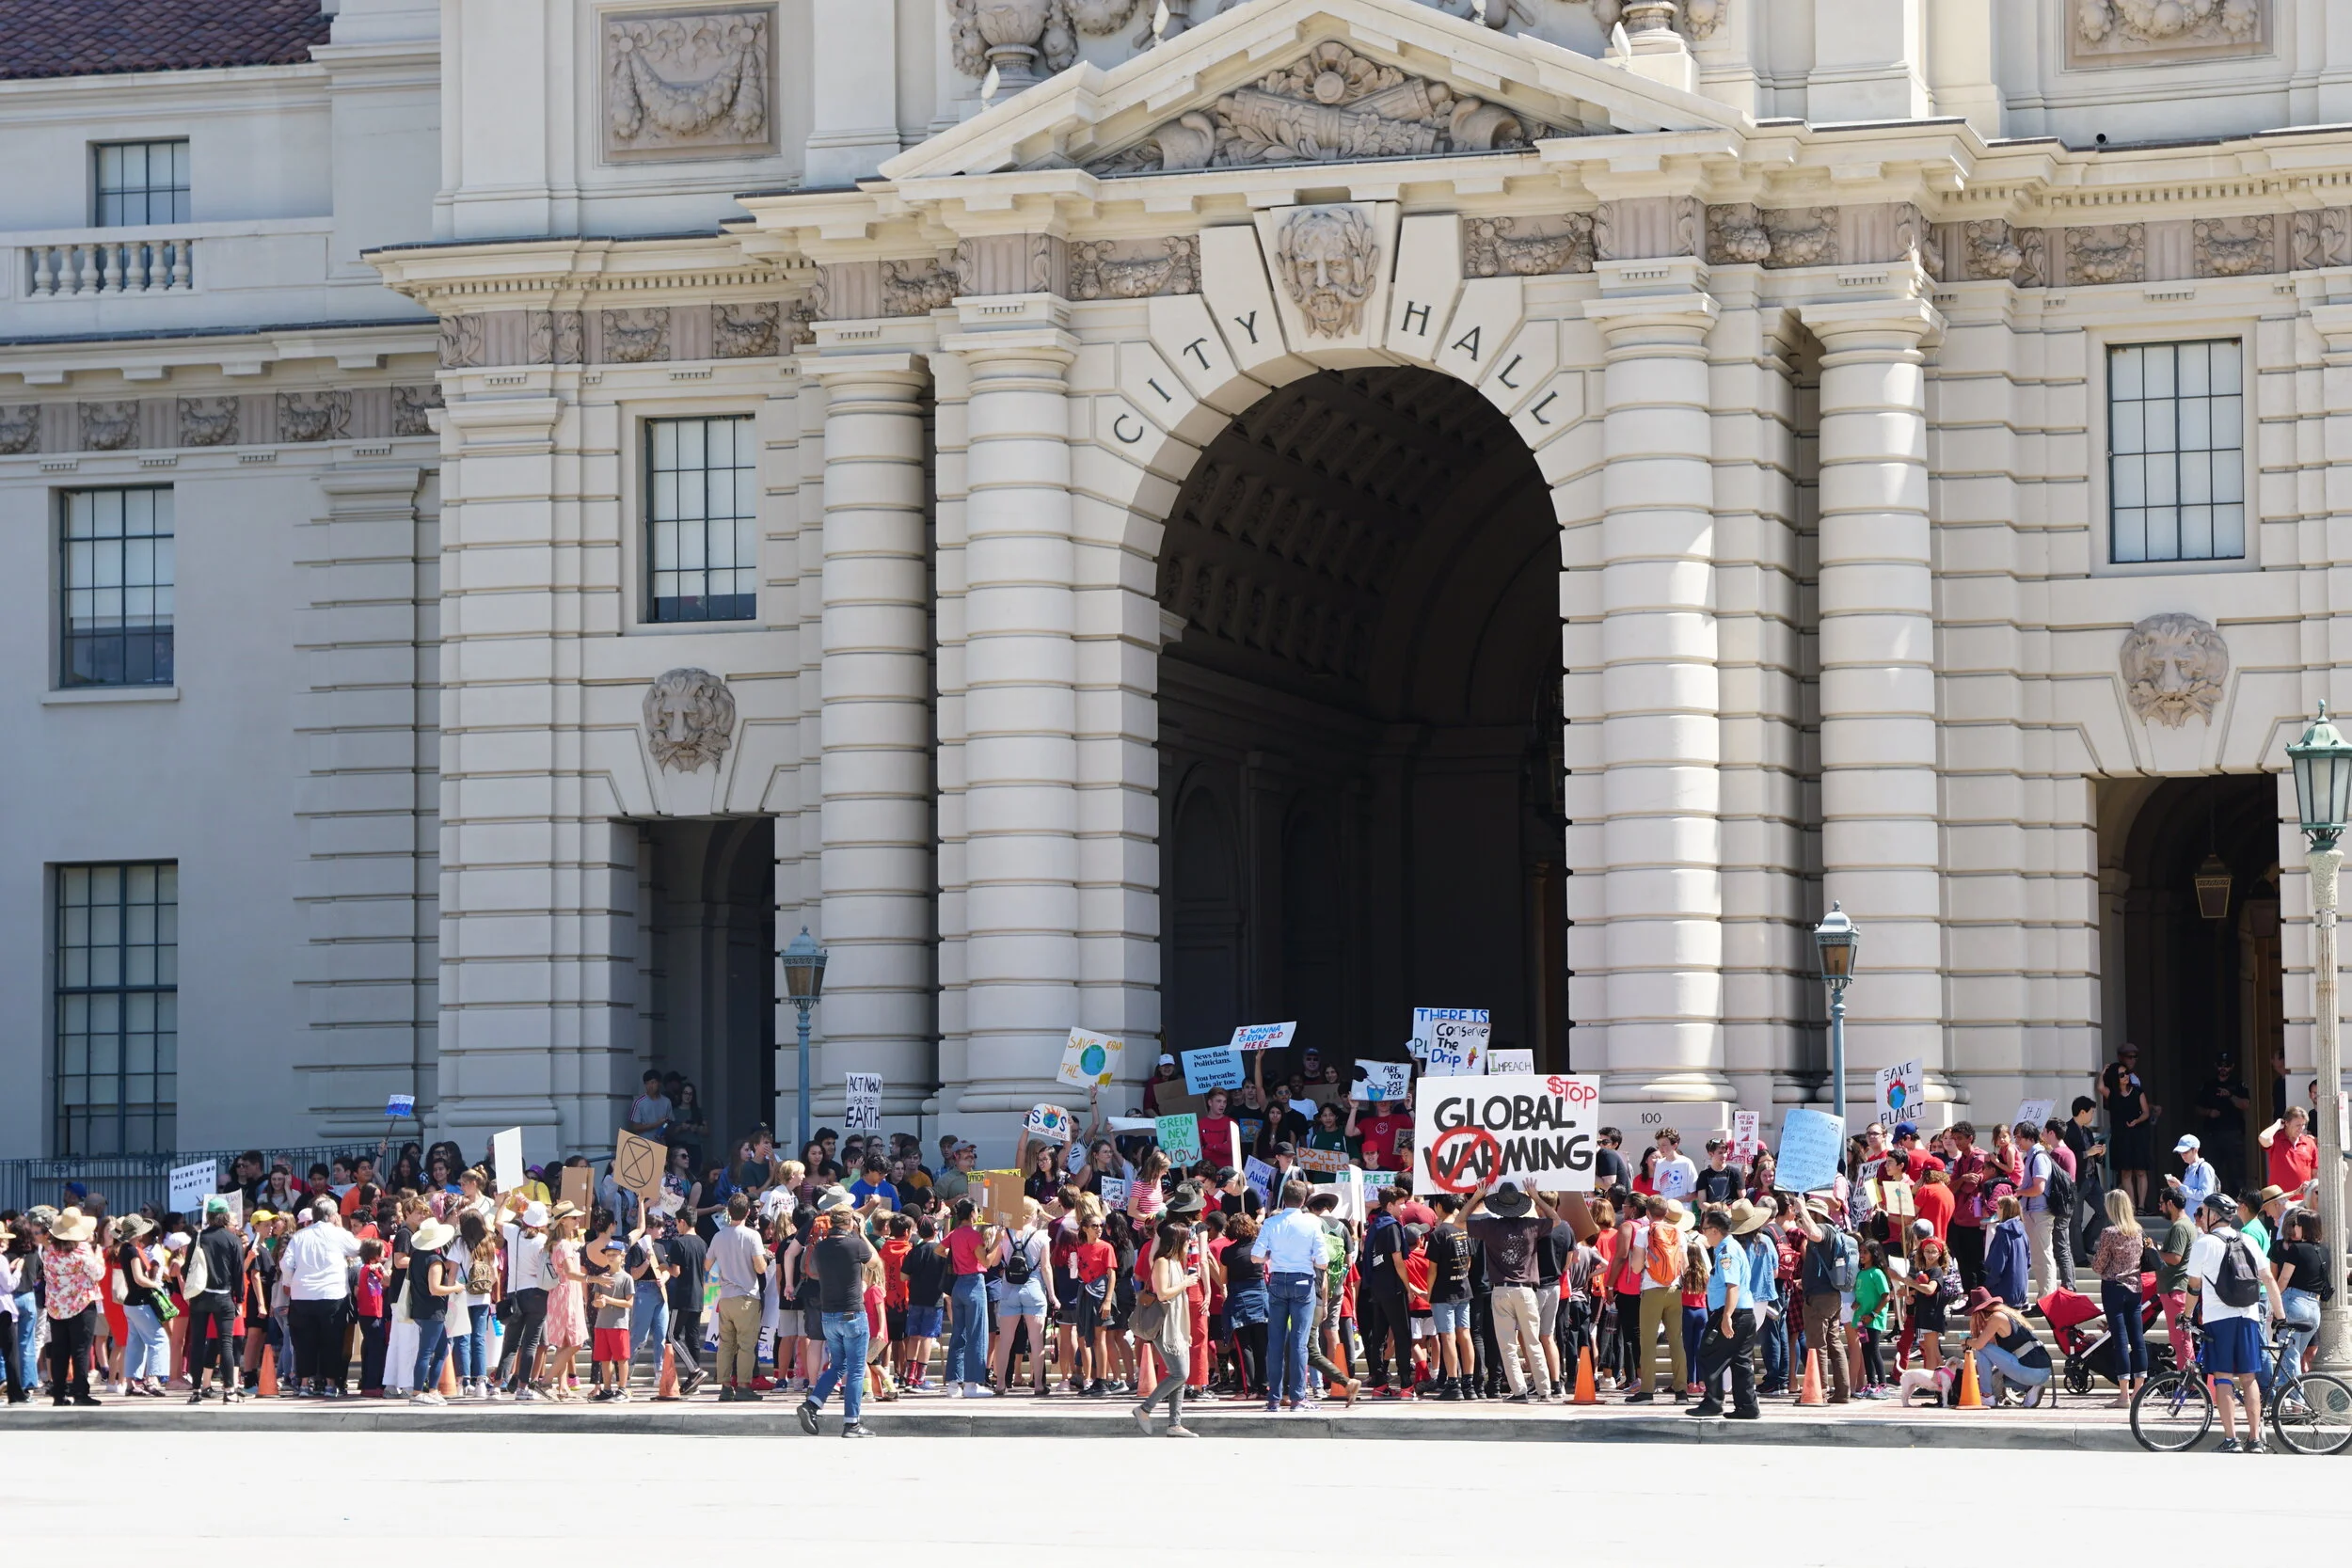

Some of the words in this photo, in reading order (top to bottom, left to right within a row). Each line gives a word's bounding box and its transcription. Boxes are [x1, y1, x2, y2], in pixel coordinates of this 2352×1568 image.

[1113, 309, 1258, 444] CITY
[1400, 300, 1559, 426] HALL
[1416, 1008, 1467, 1022] THERE
[1471, 1009, 1488, 1023] IS
[1238, 1028, 1248, 1037] I
[1249, 1025, 1281, 1035] WANNA
[1436, 1022, 1489, 1037] Conserve
[1238, 1034, 1266, 1042] GROW
[1268, 1031, 1283, 1039] OLD
[1068, 1037, 1097, 1051] SAVE
[1244, 1039, 1270, 1050] HERE
[1437, 1037, 1459, 1050] The
[1193, 1052, 1212, 1061] News
[1213, 1050, 1230, 1058] flash
[1431, 1048, 1461, 1069] Drip
[1194, 1057, 1232, 1068] Politicians.
[1383, 1065, 1400, 1073] ARE
[1489, 1053, 1532, 1072] IMPEACH
[1061, 1063, 1079, 1079] THE
[1195, 1074, 1208, 1083] You
[1209, 1071, 1236, 1081] breathe
[1883, 1062, 1913, 1082] SAVE
[849, 1075, 864, 1093] ACT
[1198, 1080, 1212, 1089] this
[1908, 1084, 1919, 1094] THE
[853, 1096, 863, 1105] FOR
[864, 1096, 873, 1105] THE
[845, 1105, 881, 1129] EARTH
[1434, 1094, 1577, 1132] GLOBAL
[1641, 1112, 1661, 1124] 100
[1881, 1101, 1923, 1125] PLANET
[1158, 1116, 1193, 1129] GREEN
[1030, 1125, 1050, 1135] CLIMATE
[1051, 1130, 1067, 1140] JUSTICE
[1168, 1127, 1189, 1139] NEW
[1163, 1139, 1192, 1150] DEAL
[1298, 1148, 1316, 1159] DO
[1324, 1150, 1343, 1163] IT
[1422, 1134, 1594, 1180] WARMING
[1248, 1158, 1257, 1166] IF
[1258, 1164, 1270, 1175] YOU
[170, 1170, 194, 1182] THERE
[173, 1179, 202, 1192] PLANET
